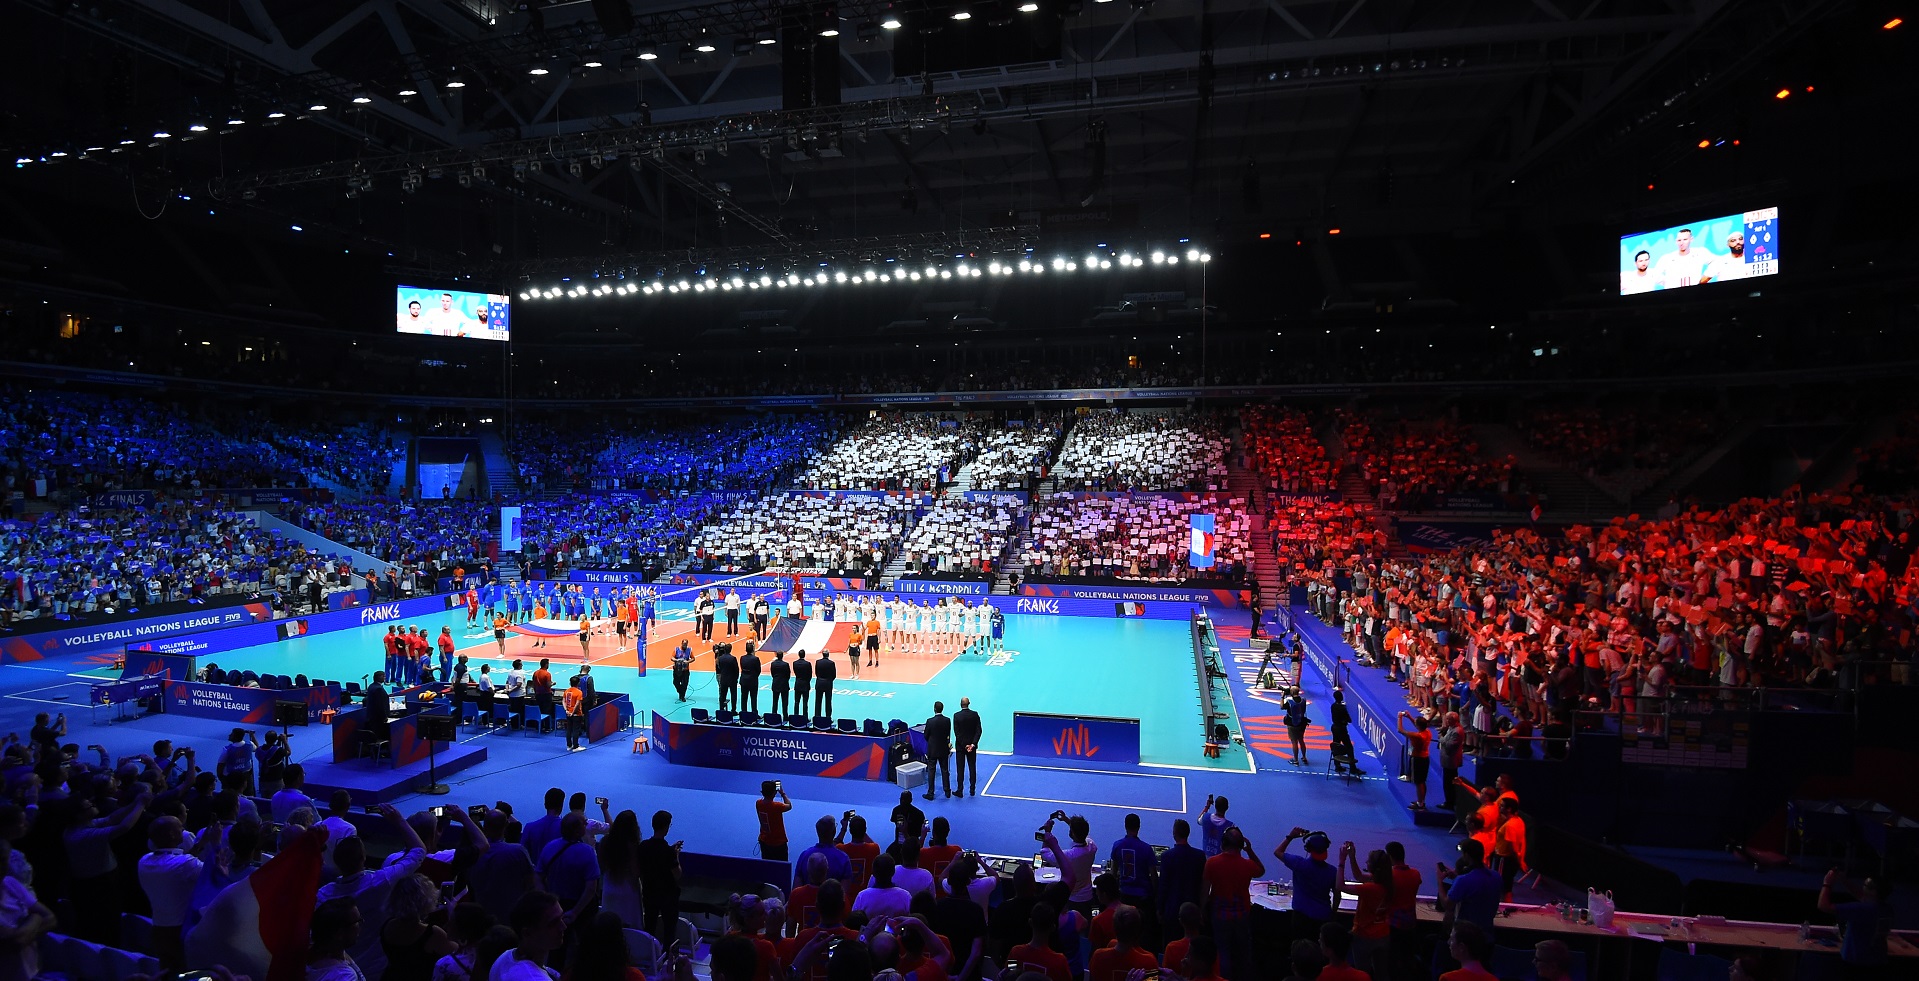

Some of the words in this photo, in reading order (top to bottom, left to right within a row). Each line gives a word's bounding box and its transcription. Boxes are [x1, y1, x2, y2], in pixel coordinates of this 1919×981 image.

[110, 494, 145, 506] FINALS
[710, 492, 724, 502] THE
[1280, 495, 1297, 506] THE
[1074, 591, 1120, 599] VOLLEYBALL
[1123, 592, 1156, 601] NATIONS
[1160, 593, 1190, 601] LEAGUE
[1017, 598, 1060, 614] FRANCE
[361, 603, 400, 624] FRANCE
[64, 629, 133, 646] VOLLEYBALL
[136, 621, 181, 636] NATIONS
[184, 616, 220, 629] LEAGUE
[159, 640, 195, 650] VOLLEYBALL
[186, 643, 208, 652] LEAGUE
[192, 689, 233, 701] VOLLEYBALL
[193, 699, 222, 709] NATIONS
[223, 701, 251, 712] LEAGUE
[1357, 704, 1368, 736] THE
[1369, 718, 1387, 757] FINALS
[743, 736, 808, 750] VOLLEYBALL
[1052, 723, 1100, 757] VNL
[743, 748, 789, 760] NATIONS
[792, 751, 834, 763] LEAGUE
